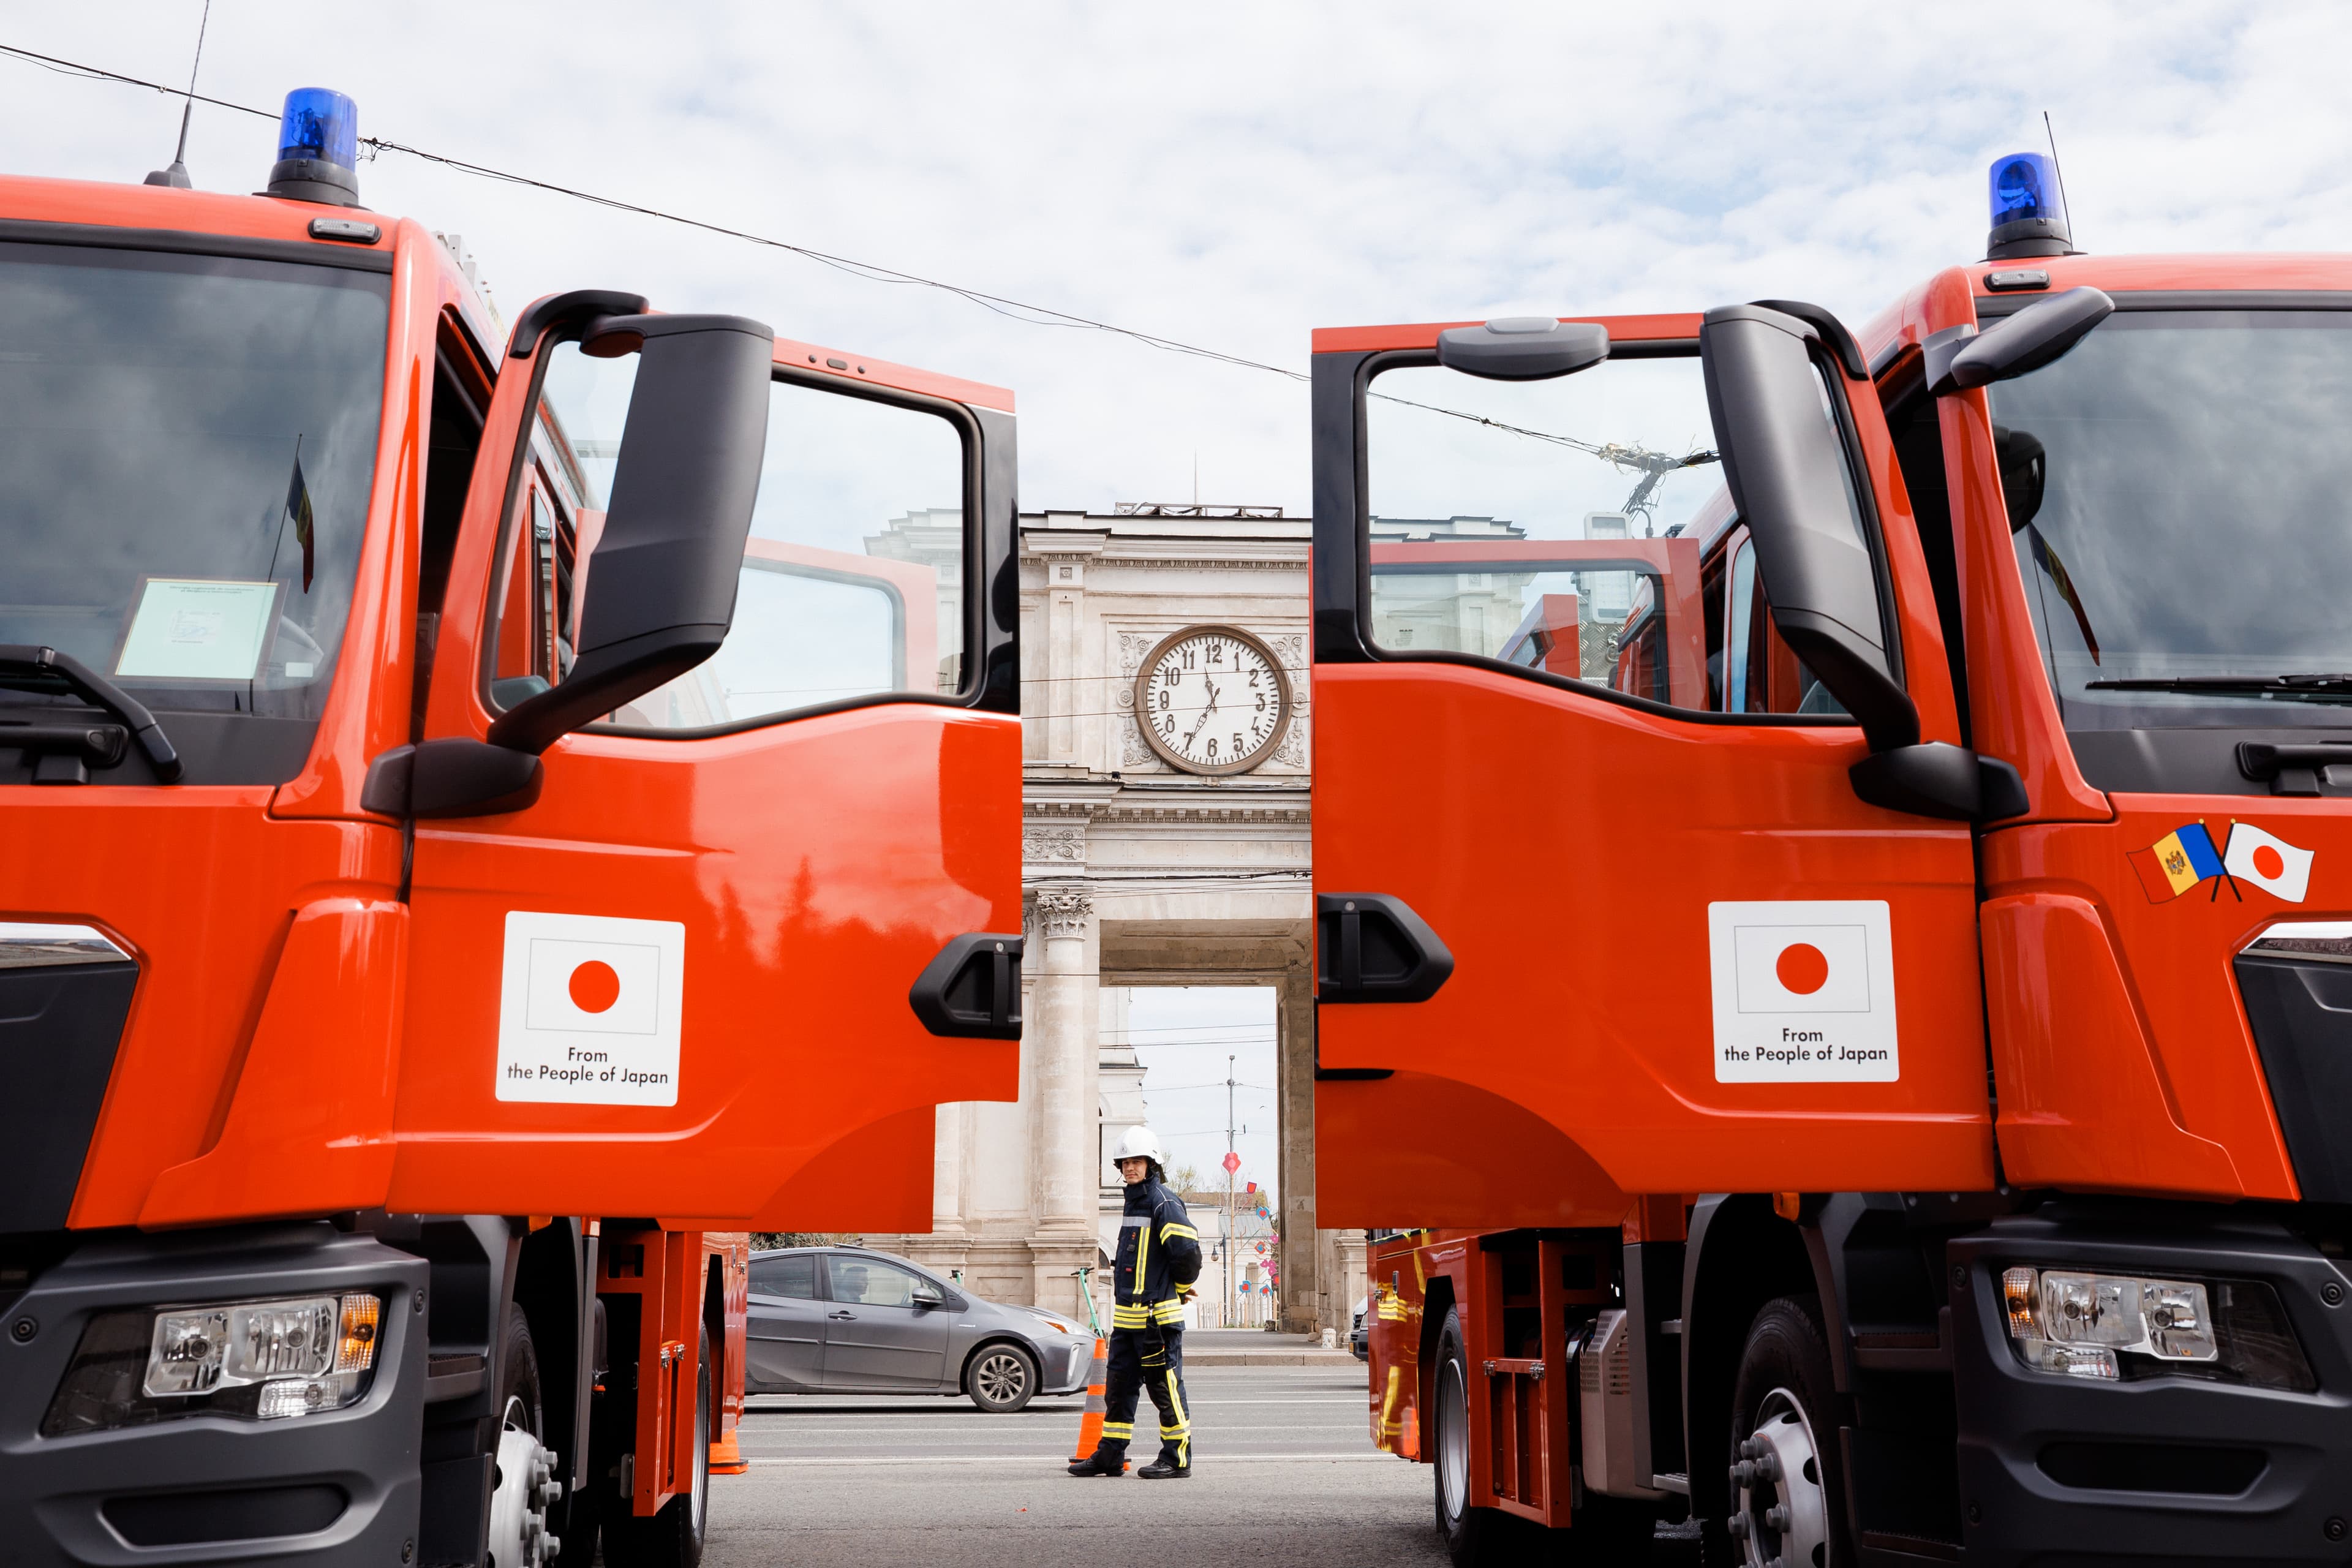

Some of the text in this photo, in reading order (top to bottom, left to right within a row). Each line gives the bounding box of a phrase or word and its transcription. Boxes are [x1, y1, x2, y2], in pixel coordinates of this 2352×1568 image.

[1183, 650, 1195, 669] 11
[1205, 644, 1223, 663] 12
[1234, 652, 1240, 671] 1
[1164, 667, 1180, 686] 10
[1249, 668, 1259, 687] 2
[1159, 690, 1170, 709] 9
[1256, 693, 1265, 712] 3
[1165, 714, 1175, 733] 8
[1251, 717, 1260, 736] 4
[1184, 732, 1194, 751] 7
[1207, 738, 1218, 757] 6
[1234, 733, 1243, 752] 5
[1782, 1028, 1823, 1042] From
[568, 1047, 608, 1063] From
[1724, 1044, 1888, 1065] the People of Japan
[507, 1063, 668, 1088] the People of Japan
